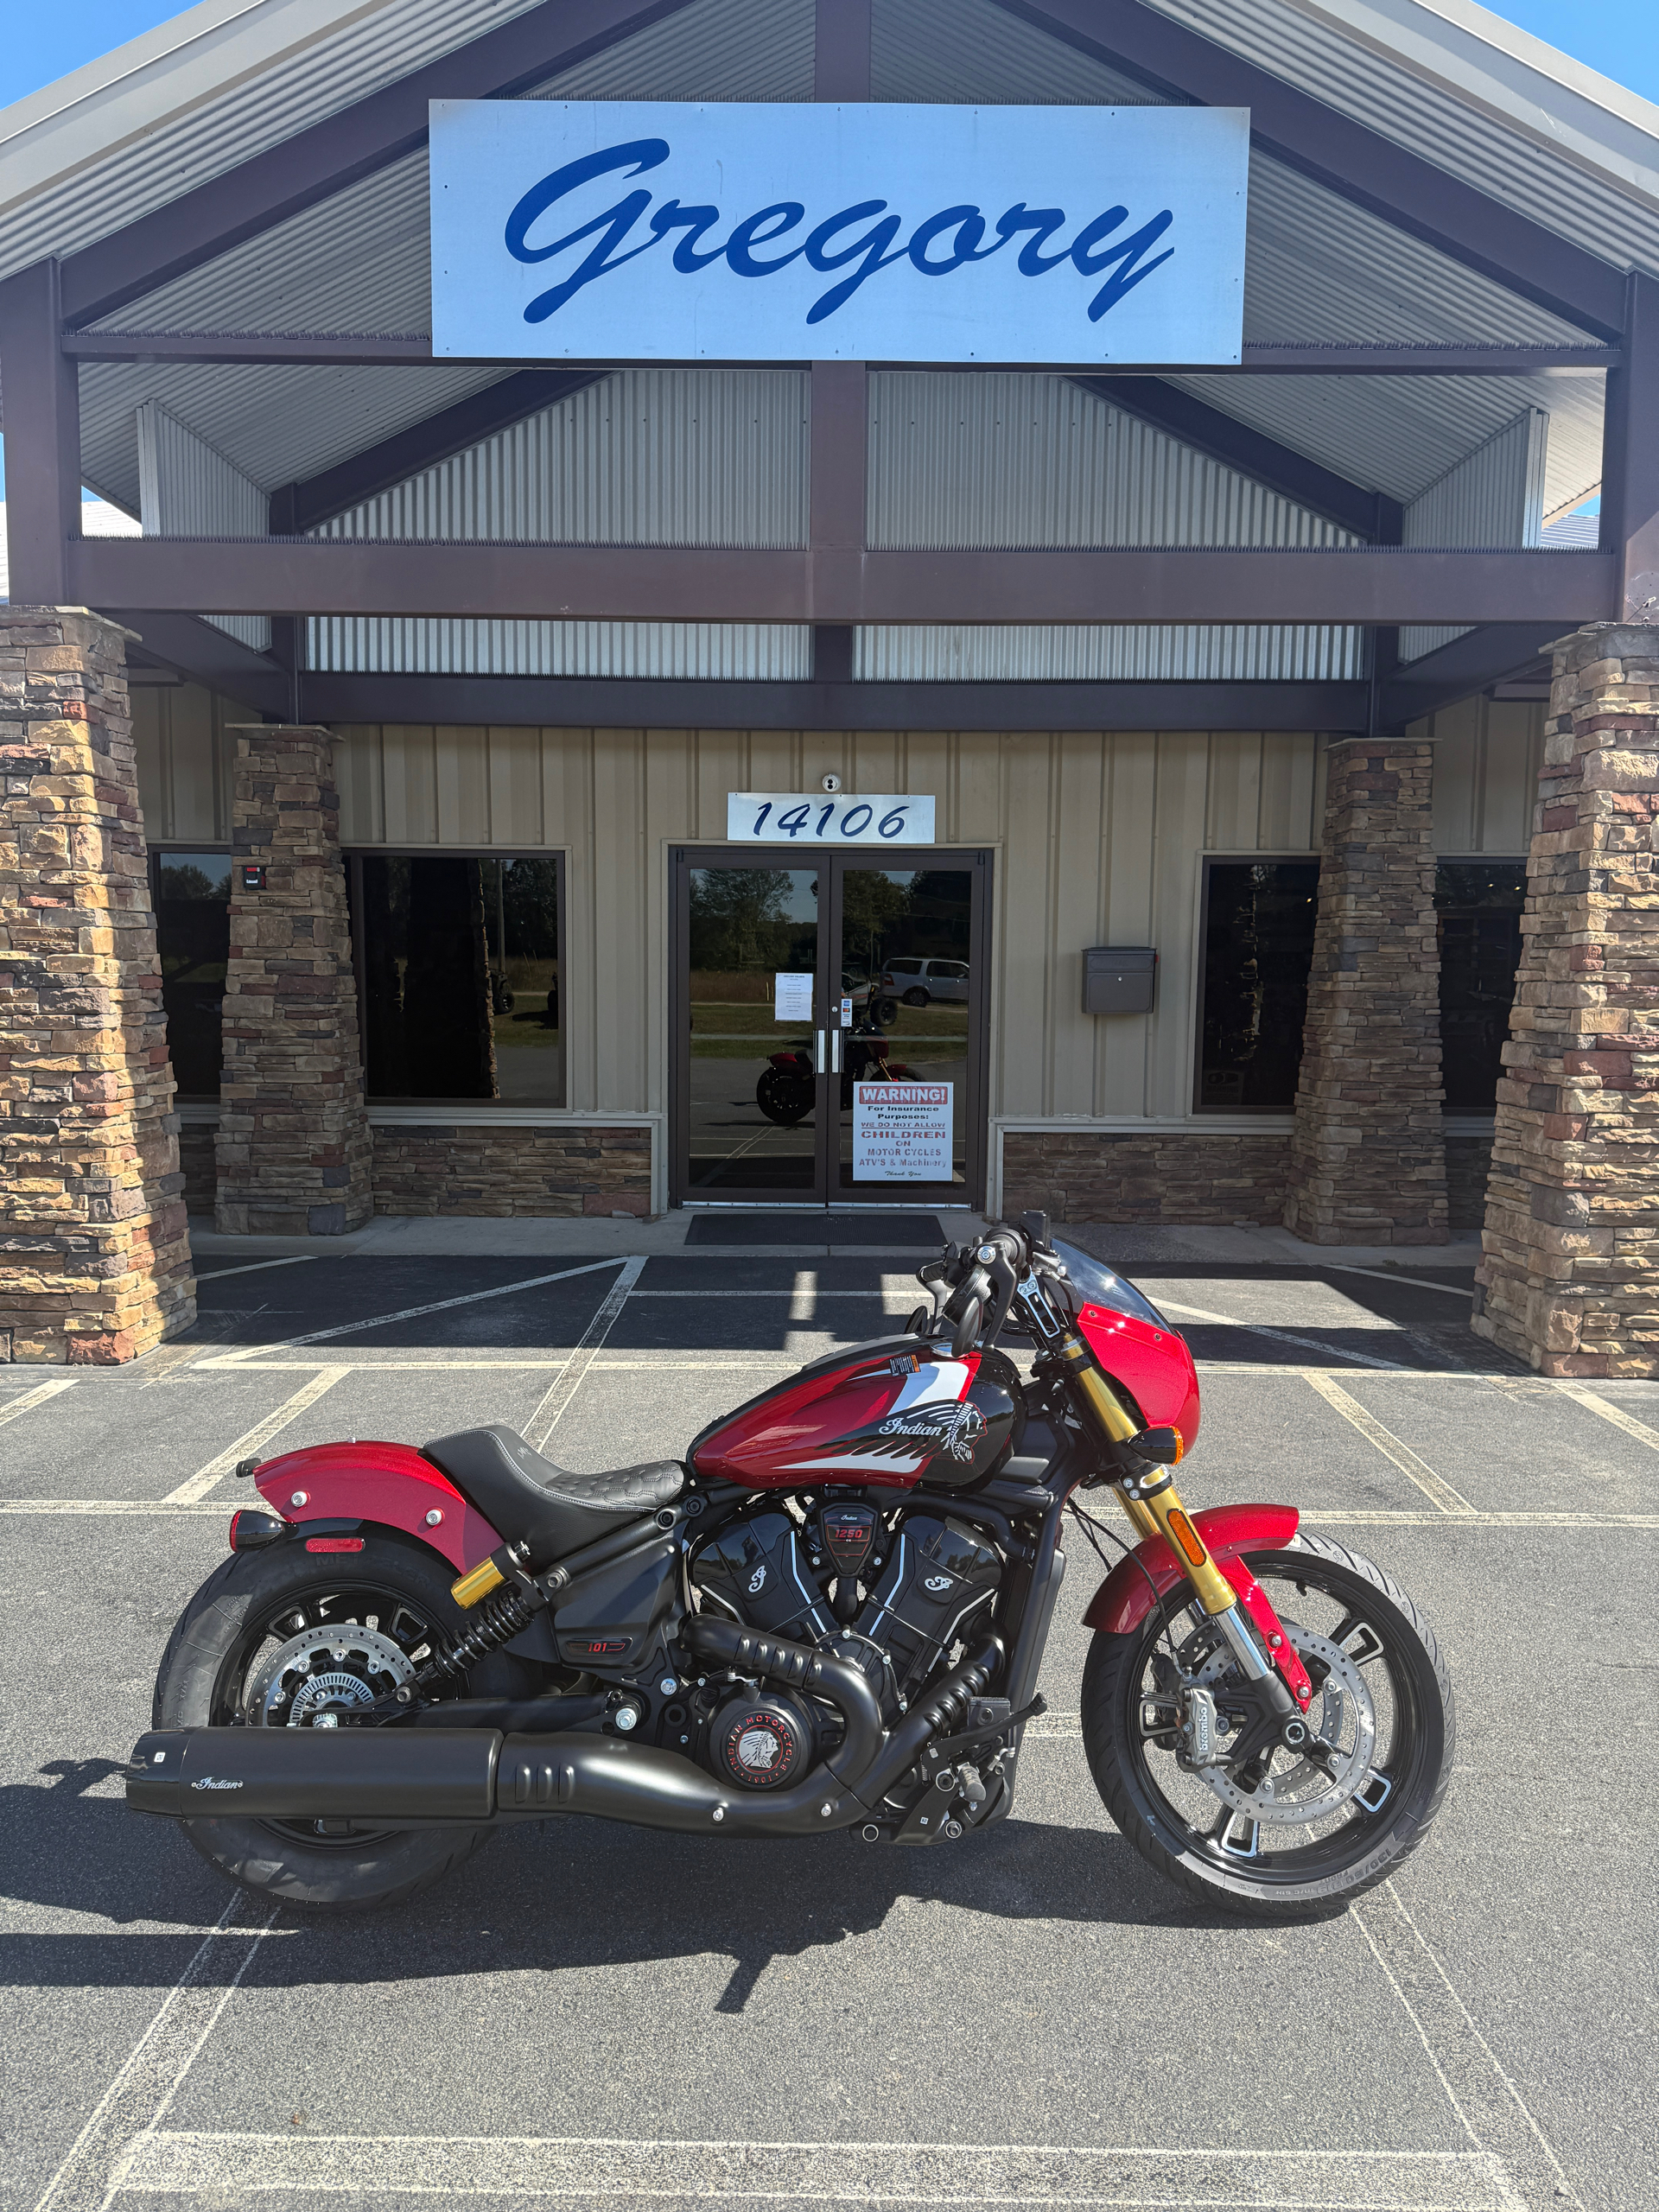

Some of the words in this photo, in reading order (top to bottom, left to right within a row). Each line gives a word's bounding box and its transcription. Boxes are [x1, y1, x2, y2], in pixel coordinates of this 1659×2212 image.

[504, 137, 1175, 325] Gregory
[753, 802, 910, 838] 14106
[861, 1088, 945, 1103] WARNING!
[899, 1159, 947, 1168] Machinery
[878, 1417, 943, 1436] Indian
[835, 1529, 863, 1538] 1250
[588, 1643, 607, 1652] 101
[1198, 1707, 1209, 1751] brembo
[728, 1724, 743, 1770] INDIAN
[746, 1714, 793, 1771] MOTORCYCLE
[195, 1777, 238, 1790] Indian
